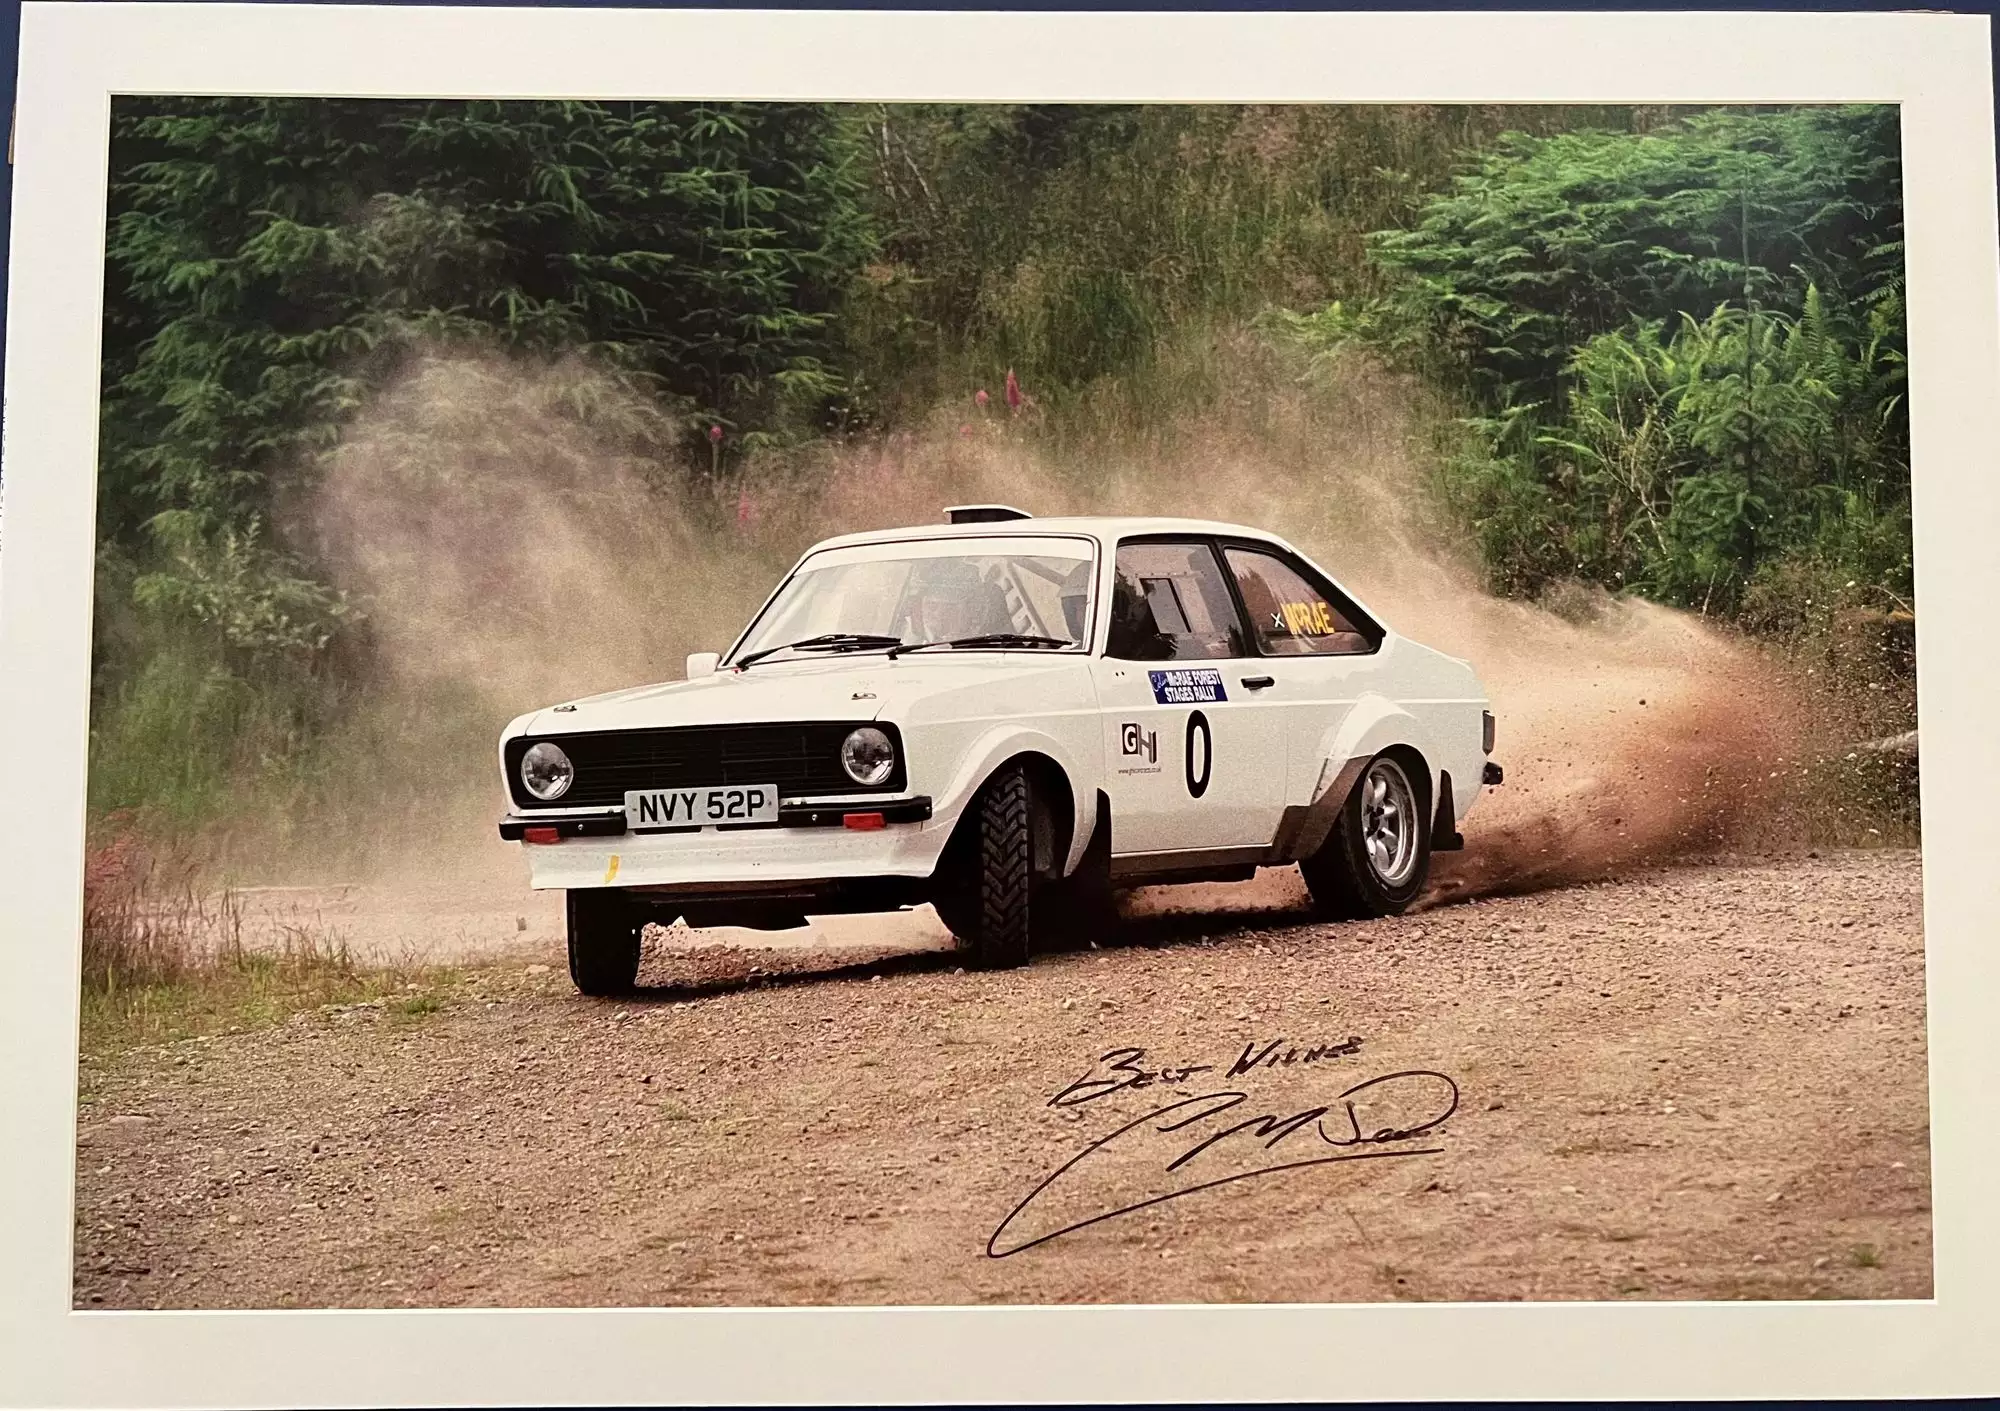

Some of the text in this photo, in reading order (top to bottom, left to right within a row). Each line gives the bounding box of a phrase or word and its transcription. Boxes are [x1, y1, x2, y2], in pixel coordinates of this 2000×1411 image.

[1191, 670, 1221, 685] FOREST
[1164, 685, 1217, 702] STAGES RALLY
[1185, 709, 1212, 799] 0
[640, 789, 765, 822] NVY 52P
